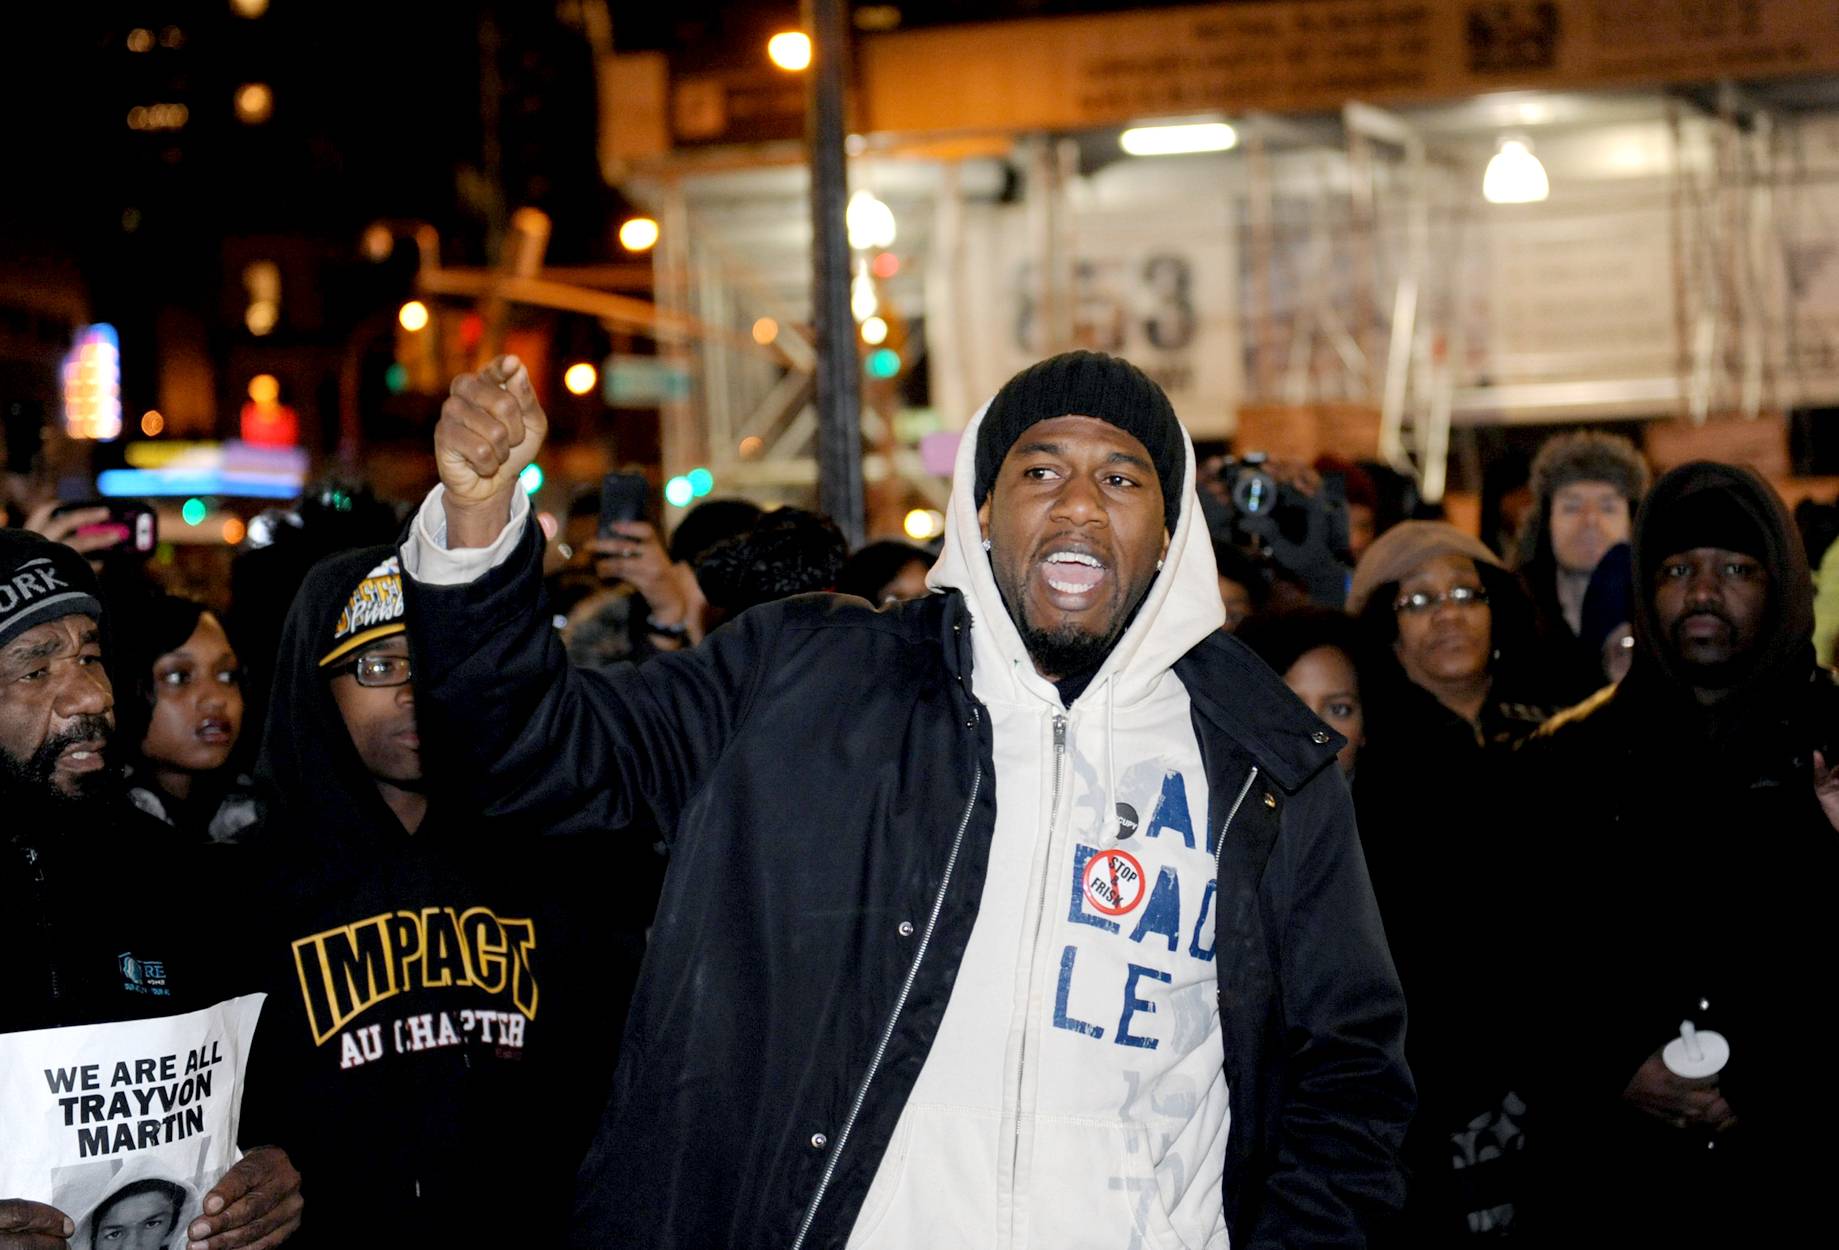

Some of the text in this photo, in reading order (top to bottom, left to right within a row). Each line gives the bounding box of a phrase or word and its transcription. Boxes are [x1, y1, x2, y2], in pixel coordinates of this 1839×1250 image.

[1090, 878, 1124, 909] FRISK
[1109, 856, 1138, 882] STOP
[291, 906, 538, 1047] IMPACT
[44, 1041, 222, 1094] WE ARE ALL
[340, 1024, 383, 1069] AU
[58, 1070, 212, 1126] TRAYVON
[77, 1105, 204, 1158] MARTIN
